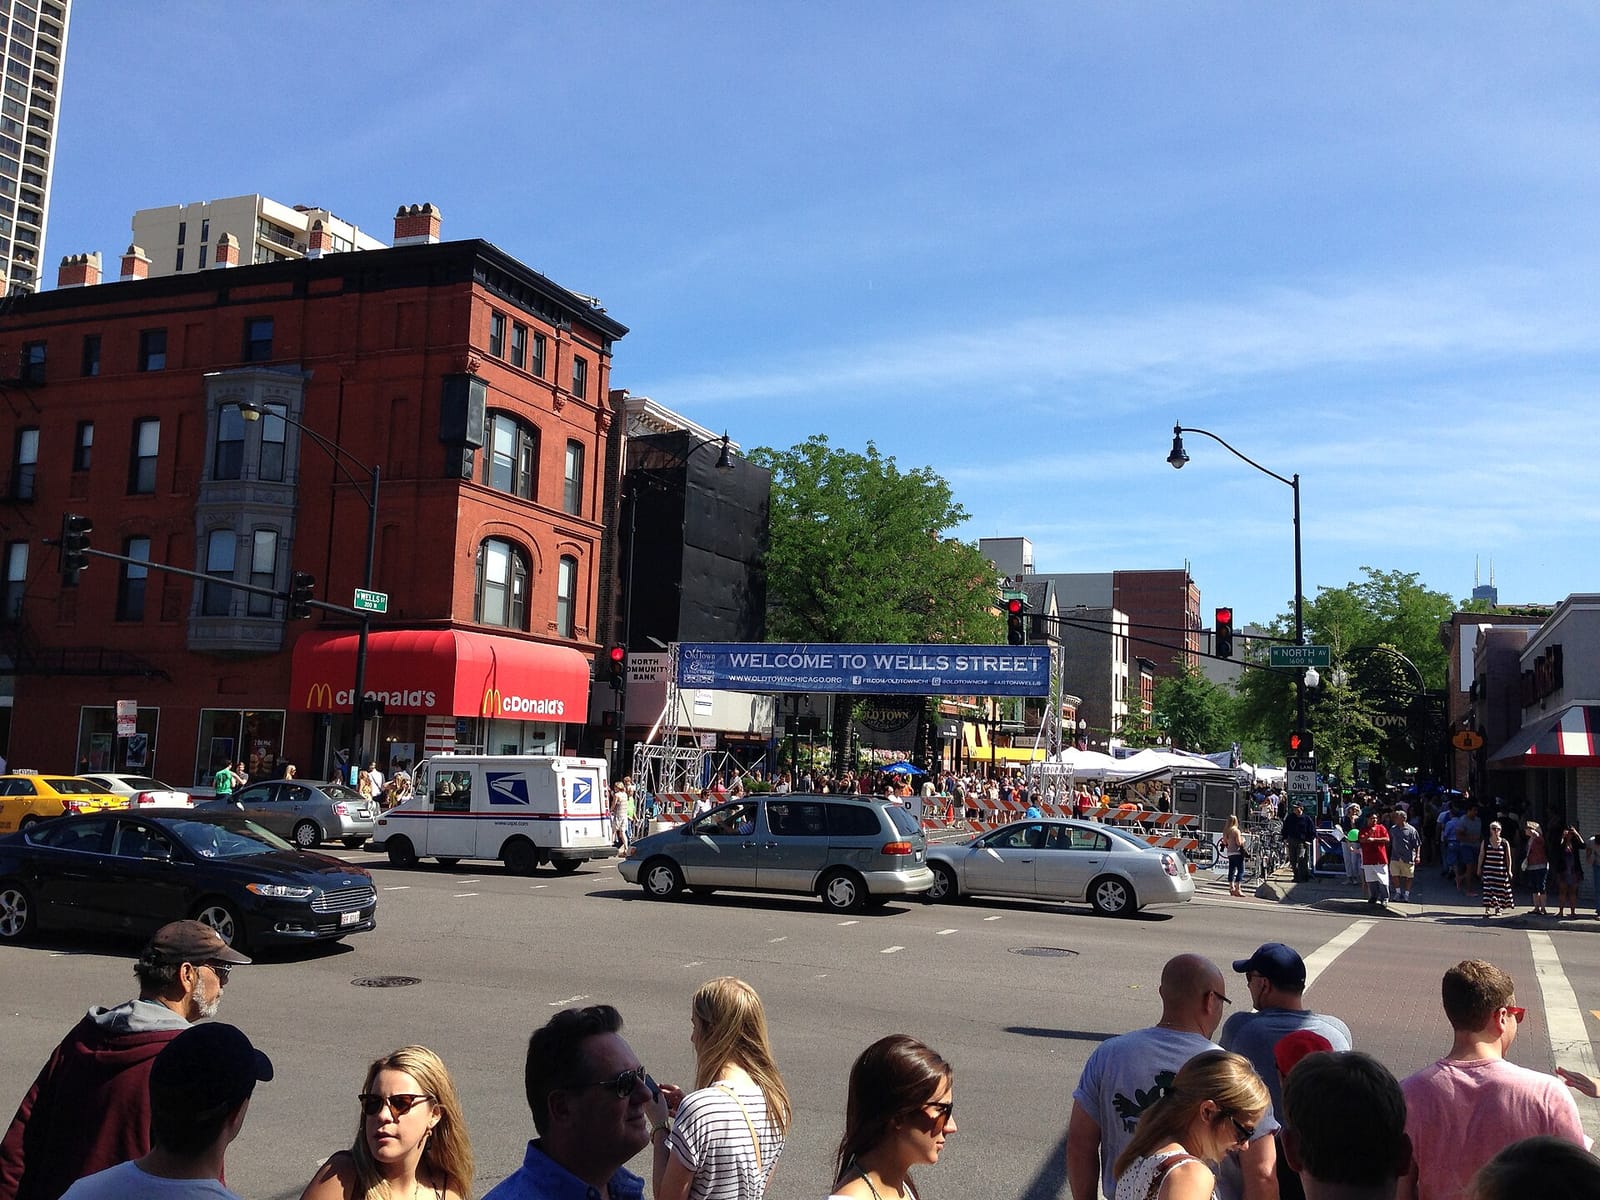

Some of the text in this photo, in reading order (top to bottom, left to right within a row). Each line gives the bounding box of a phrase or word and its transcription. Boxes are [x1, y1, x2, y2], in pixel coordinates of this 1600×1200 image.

[361, 592, 380, 603] WELLS
[697, 649, 716, 660] Town
[1281, 648, 1315, 657] NORTH
[729, 653, 833, 669] WELCOME
[838, 654, 867, 669] TO
[873, 654, 950, 671] WELLS
[955, 655, 1042, 672] STREET
[728, 674, 843, 684] WWW.OLDTOWNCHICAGO.ORG
[879, 710, 909, 721] TOWN
[1369, 715, 1407, 728] TOWN
[1292, 782, 1312, 790] ONLY
